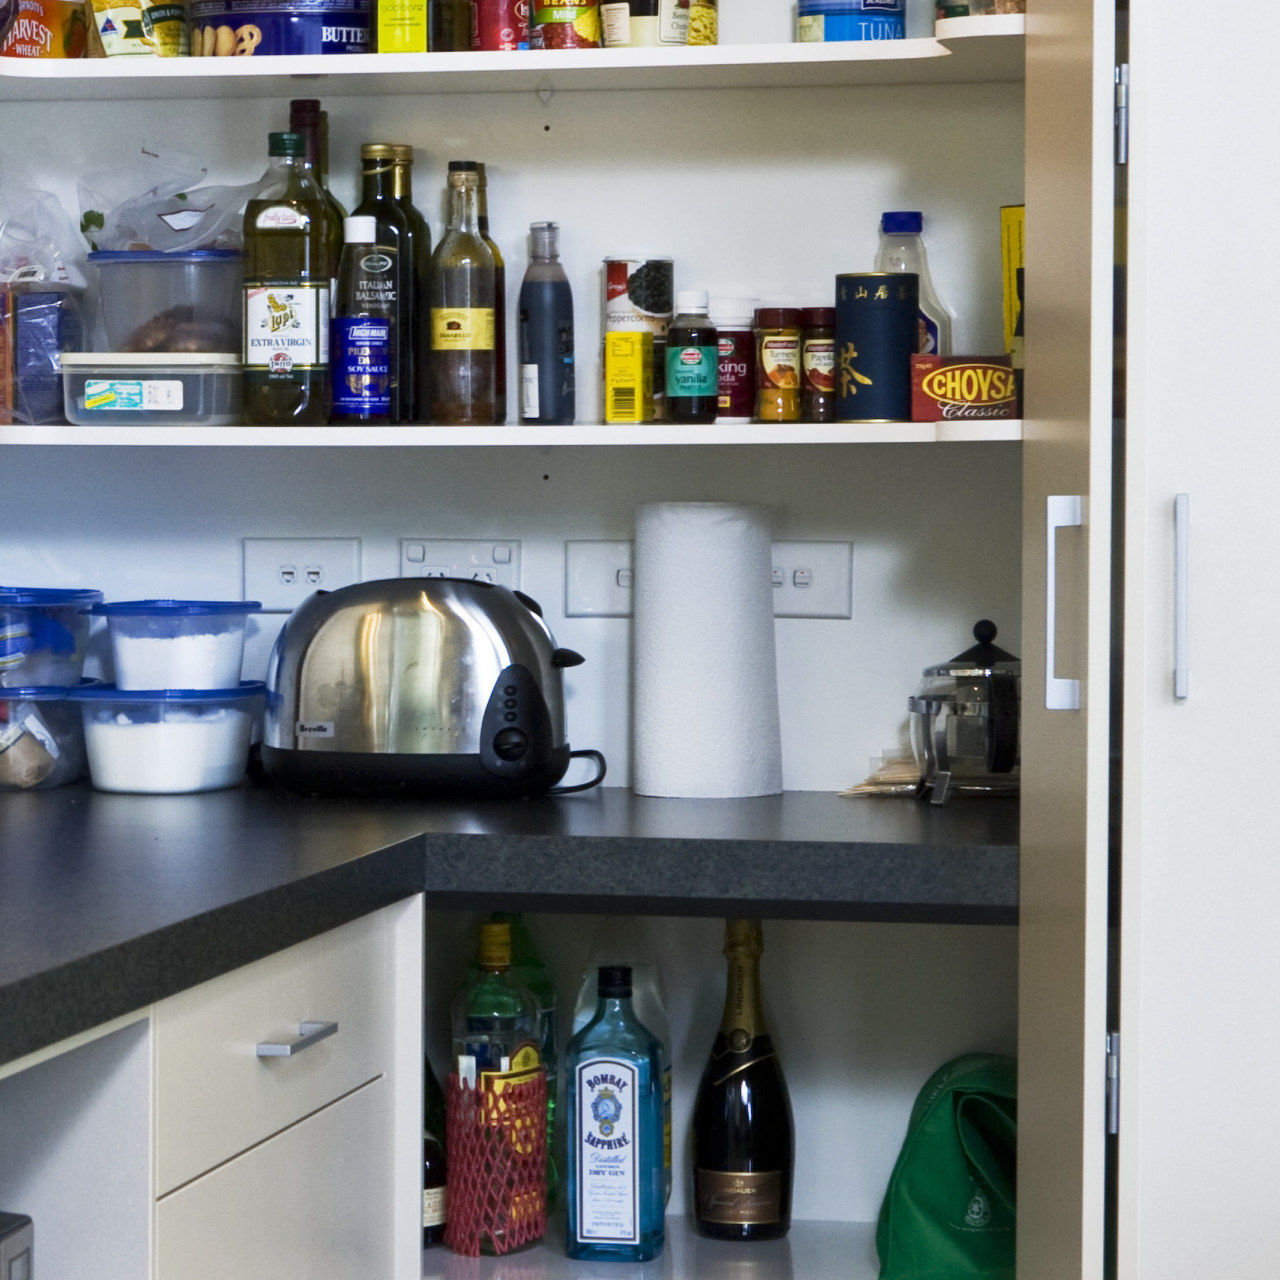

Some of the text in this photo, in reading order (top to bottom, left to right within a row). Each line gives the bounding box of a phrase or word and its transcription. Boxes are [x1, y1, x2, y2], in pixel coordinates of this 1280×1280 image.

[552, 9, 577, 20] Mild
[858, 22, 902, 41] TUNA
[359, 280, 393, 290] ITALIAN
[251, 338, 312, 347] EXTRA VIRGIN
[348, 365, 389, 373] SOY SAUCE
[675, 372, 707, 384] vanilla
[937, 400, 1010, 419] Classic
[299, 724, 328, 733] Breville
[585, 1074, 629, 1093] BOMBAY
[584, 1131, 631, 1151] SAPPHIRE
[589, 1169, 626, 1177] DRY GIN
